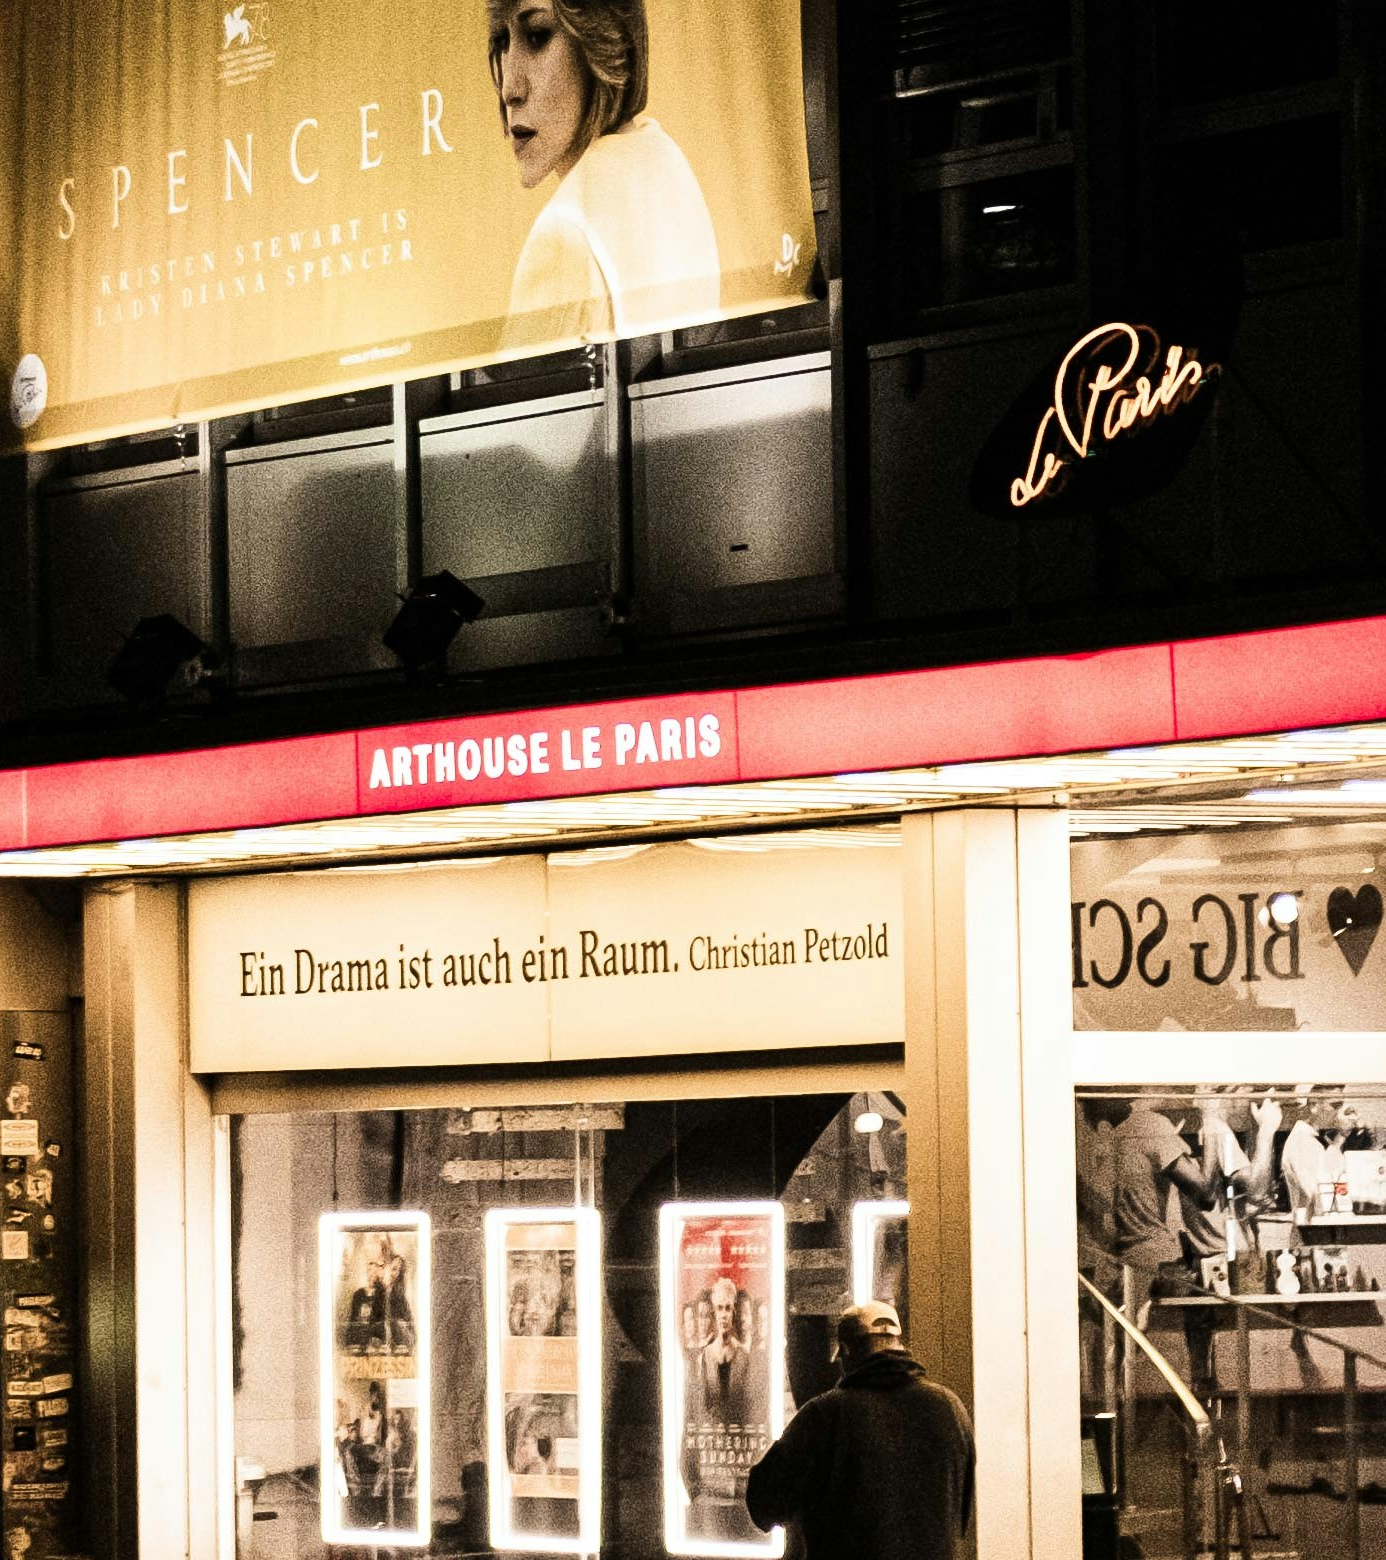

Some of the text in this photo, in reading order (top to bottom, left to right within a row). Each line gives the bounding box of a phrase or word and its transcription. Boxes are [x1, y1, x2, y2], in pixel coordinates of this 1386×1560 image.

[57, 88, 454, 240] SPENCER
[94, 238, 413, 327] LADY DIANA SPENCER
[100, 208, 408, 296] KRISTEN STEWART IS
[368, 713, 723, 789] ARTHOUSE LE PARIS
[239, 922, 889, 997] Ein Drama ist auch ein Raum. Christian Petzold
